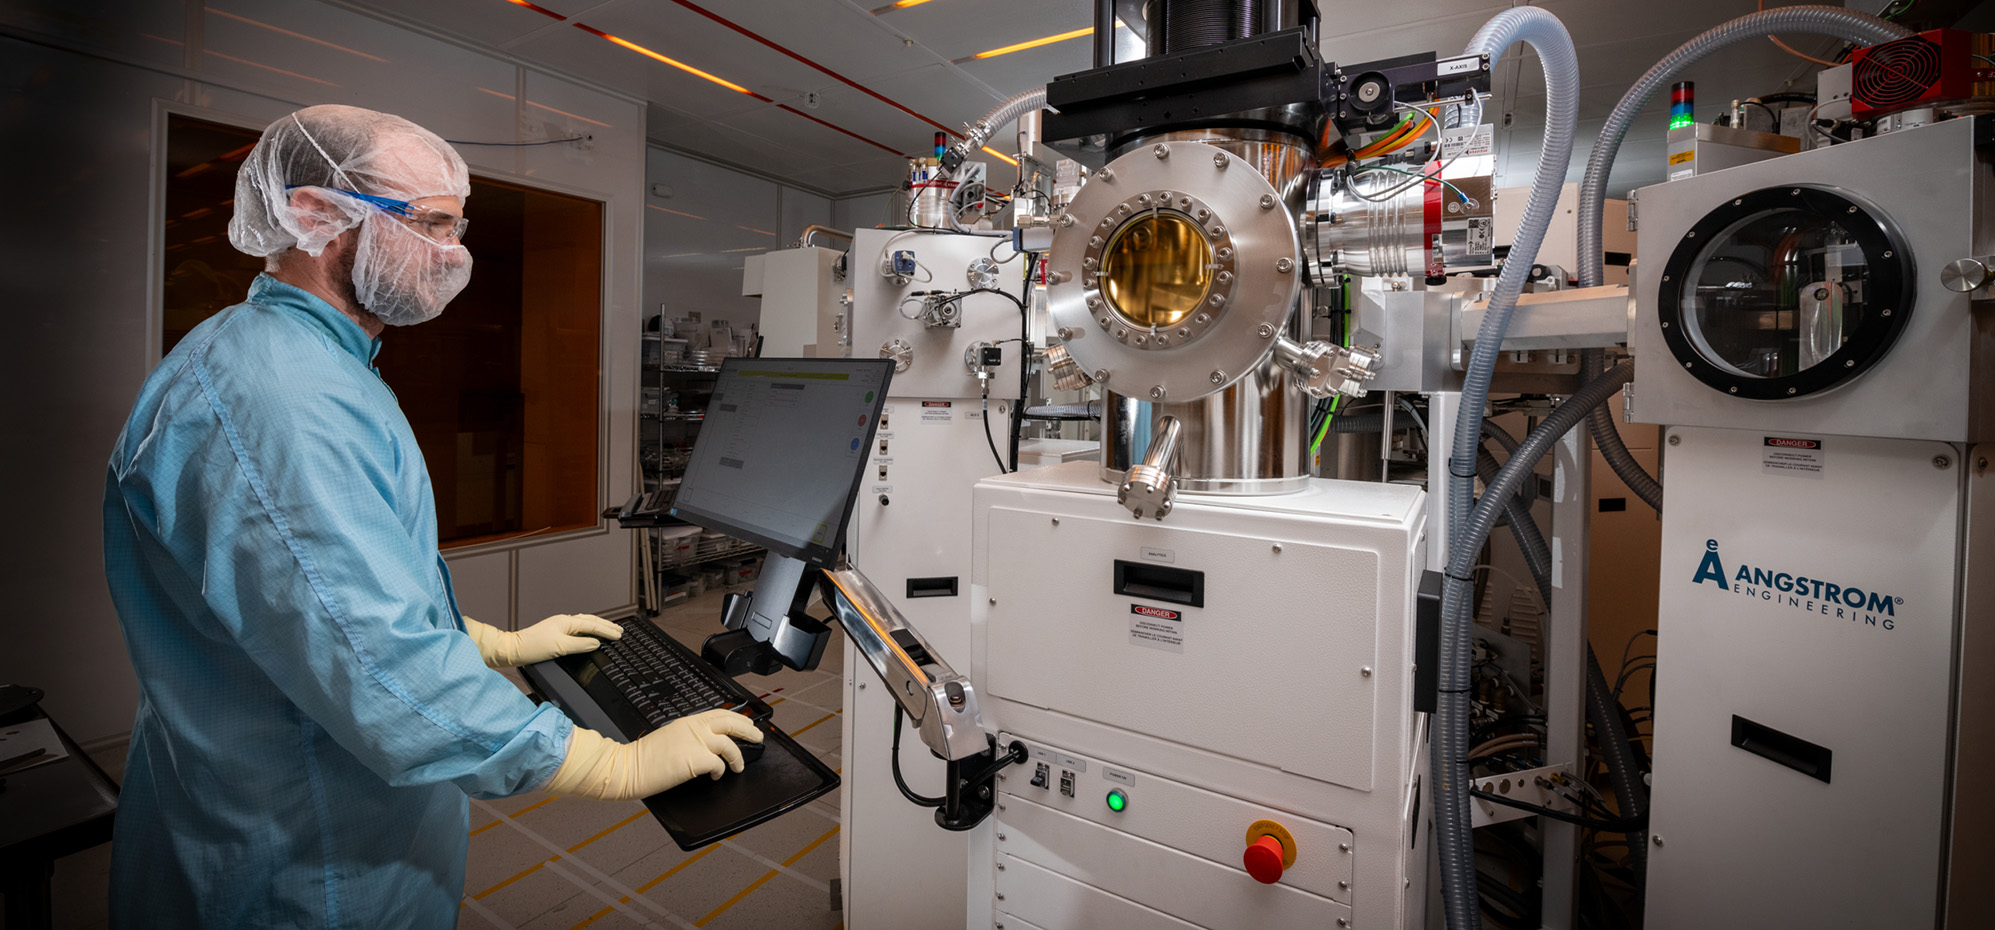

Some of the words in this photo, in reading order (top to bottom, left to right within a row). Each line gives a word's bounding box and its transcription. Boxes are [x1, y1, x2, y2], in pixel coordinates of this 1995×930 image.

[1776, 439, 1808, 448] DANGER
[1141, 607, 1170, 618] DANGER
[1734, 584, 1895, 630] ENGINEERING
